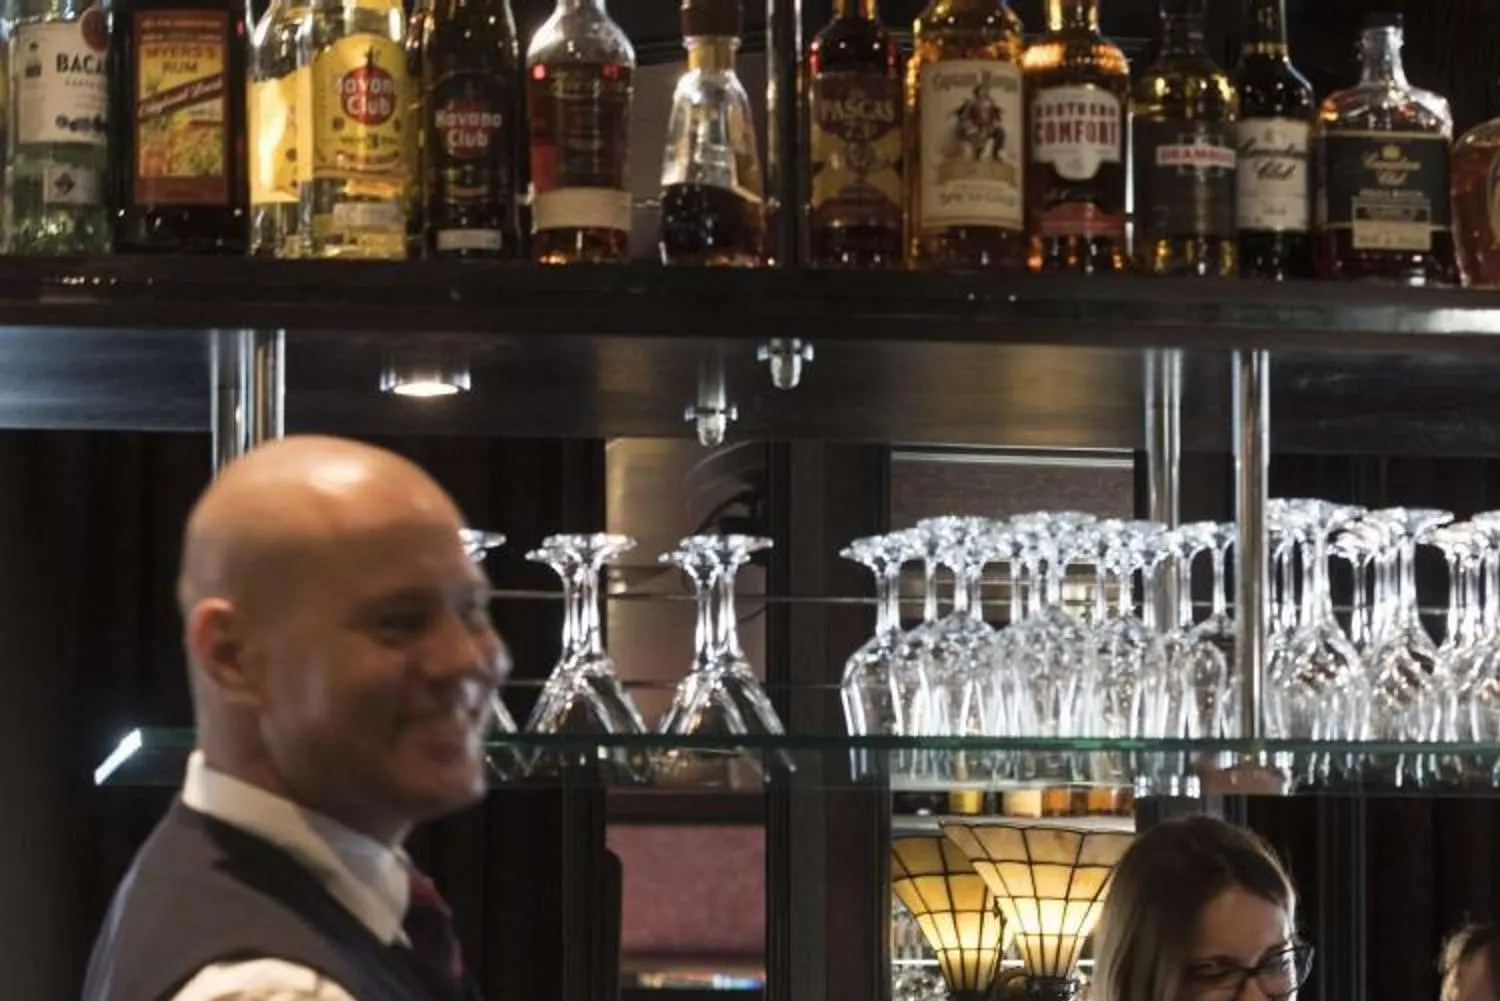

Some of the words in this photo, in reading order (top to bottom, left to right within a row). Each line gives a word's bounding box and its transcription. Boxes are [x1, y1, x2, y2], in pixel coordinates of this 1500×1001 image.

[162, 61, 198, 73] RUM
[347, 94, 391, 115] Club
[1035, 102, 1116, 117] SOUTHERN
[435, 109, 502, 129] Havana
[447, 127, 489, 148] Club
[1034, 120, 1116, 144] COMFORT
